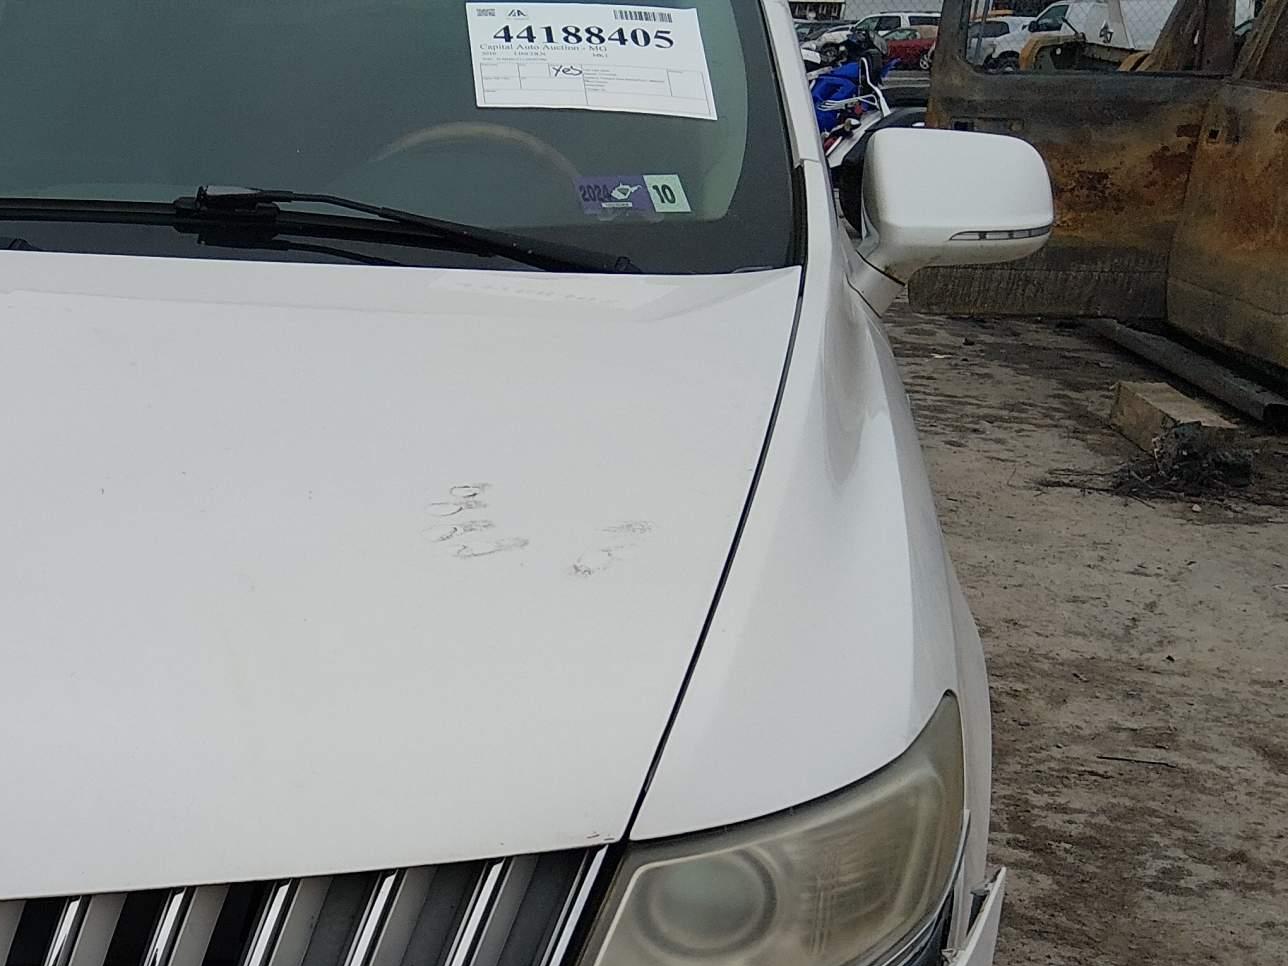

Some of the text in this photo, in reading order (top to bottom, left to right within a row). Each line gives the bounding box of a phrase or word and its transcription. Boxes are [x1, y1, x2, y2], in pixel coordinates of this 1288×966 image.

[493, 24, 674, 49] 44188405
[479, 43, 513, 52] Capital
[652, 184, 676, 204] 10
